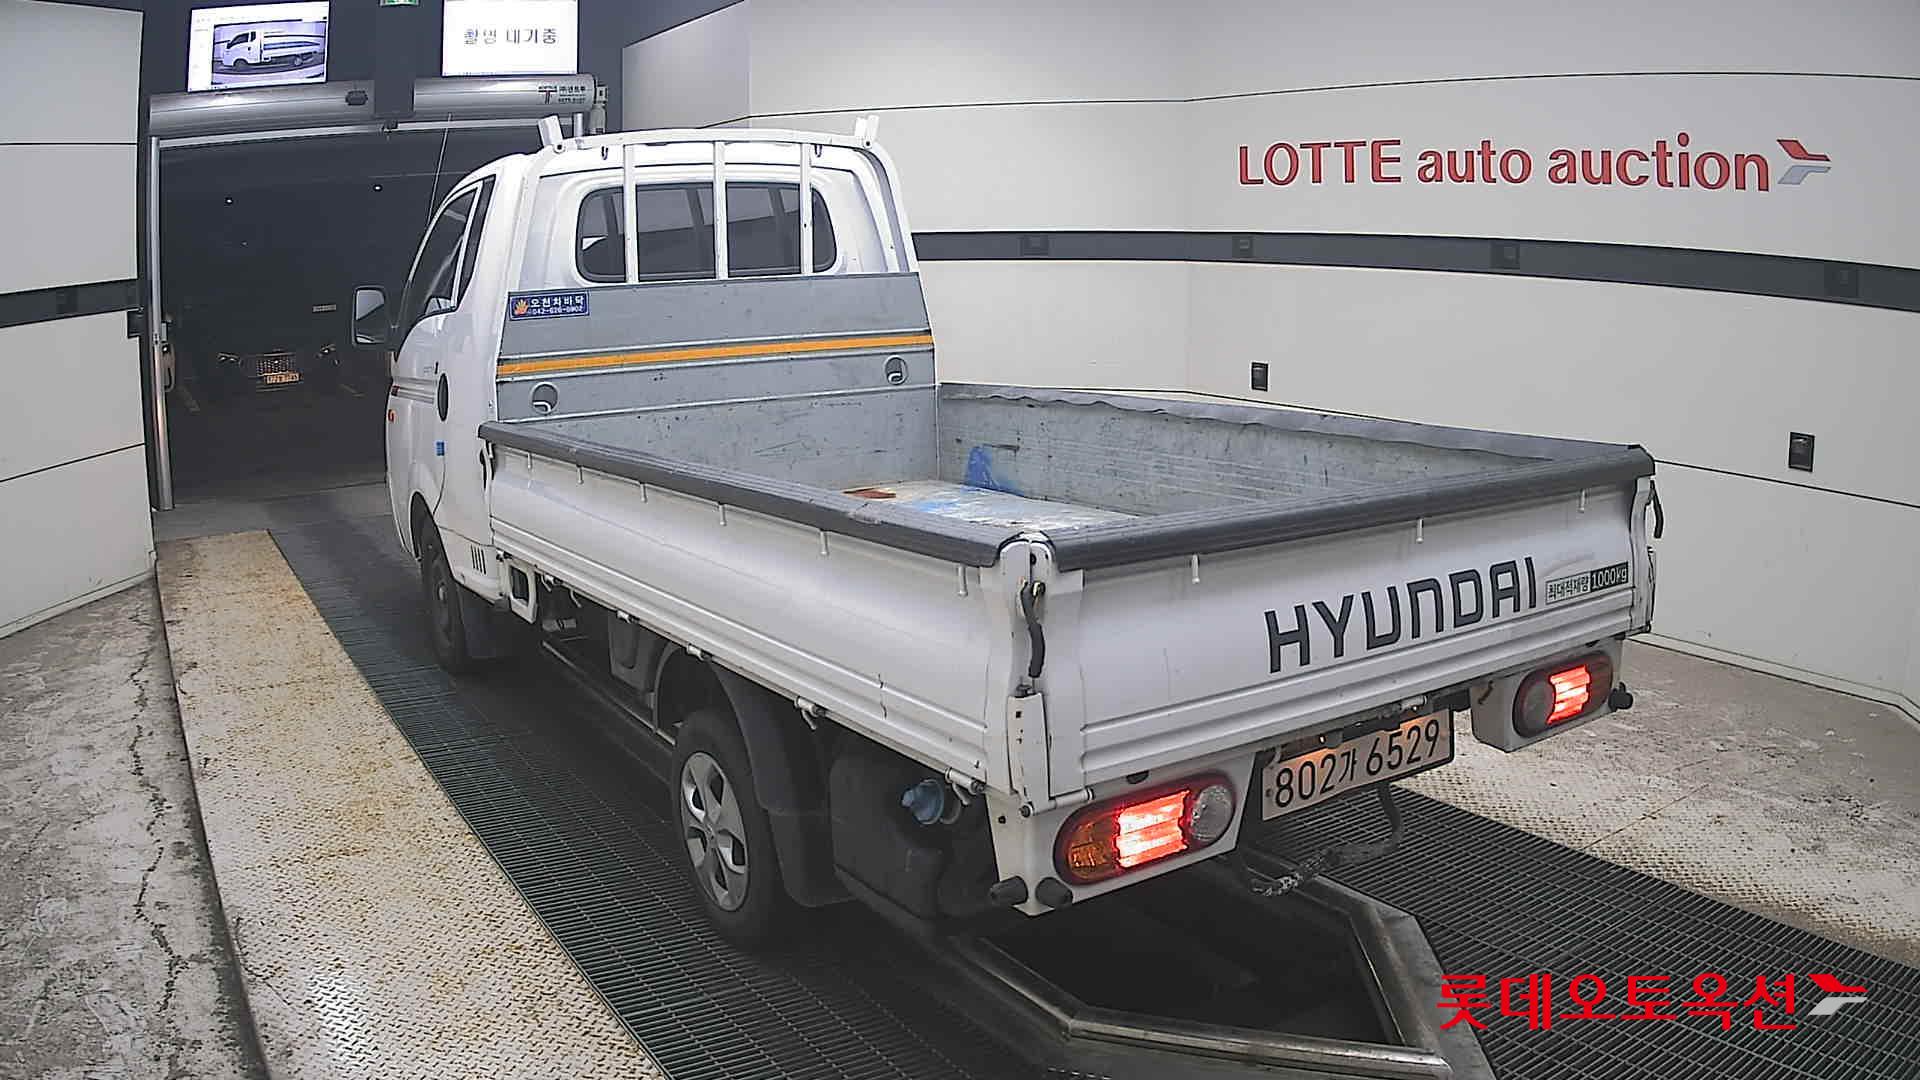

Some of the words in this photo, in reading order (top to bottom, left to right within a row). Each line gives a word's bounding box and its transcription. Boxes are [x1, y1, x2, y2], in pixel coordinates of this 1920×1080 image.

[1239, 139, 1402, 185] LOTTE
[1417, 140, 1532, 184] auto
[1549, 132, 1769, 192] auction
[1264, 556, 1537, 674] HYUNDAI
[1548, 576, 1590, 600] 최대적재량
[1591, 567, 1627, 590] 1000kg
[1275, 748, 1357, 808] 802가
[1366, 719, 1440, 776] 6529
